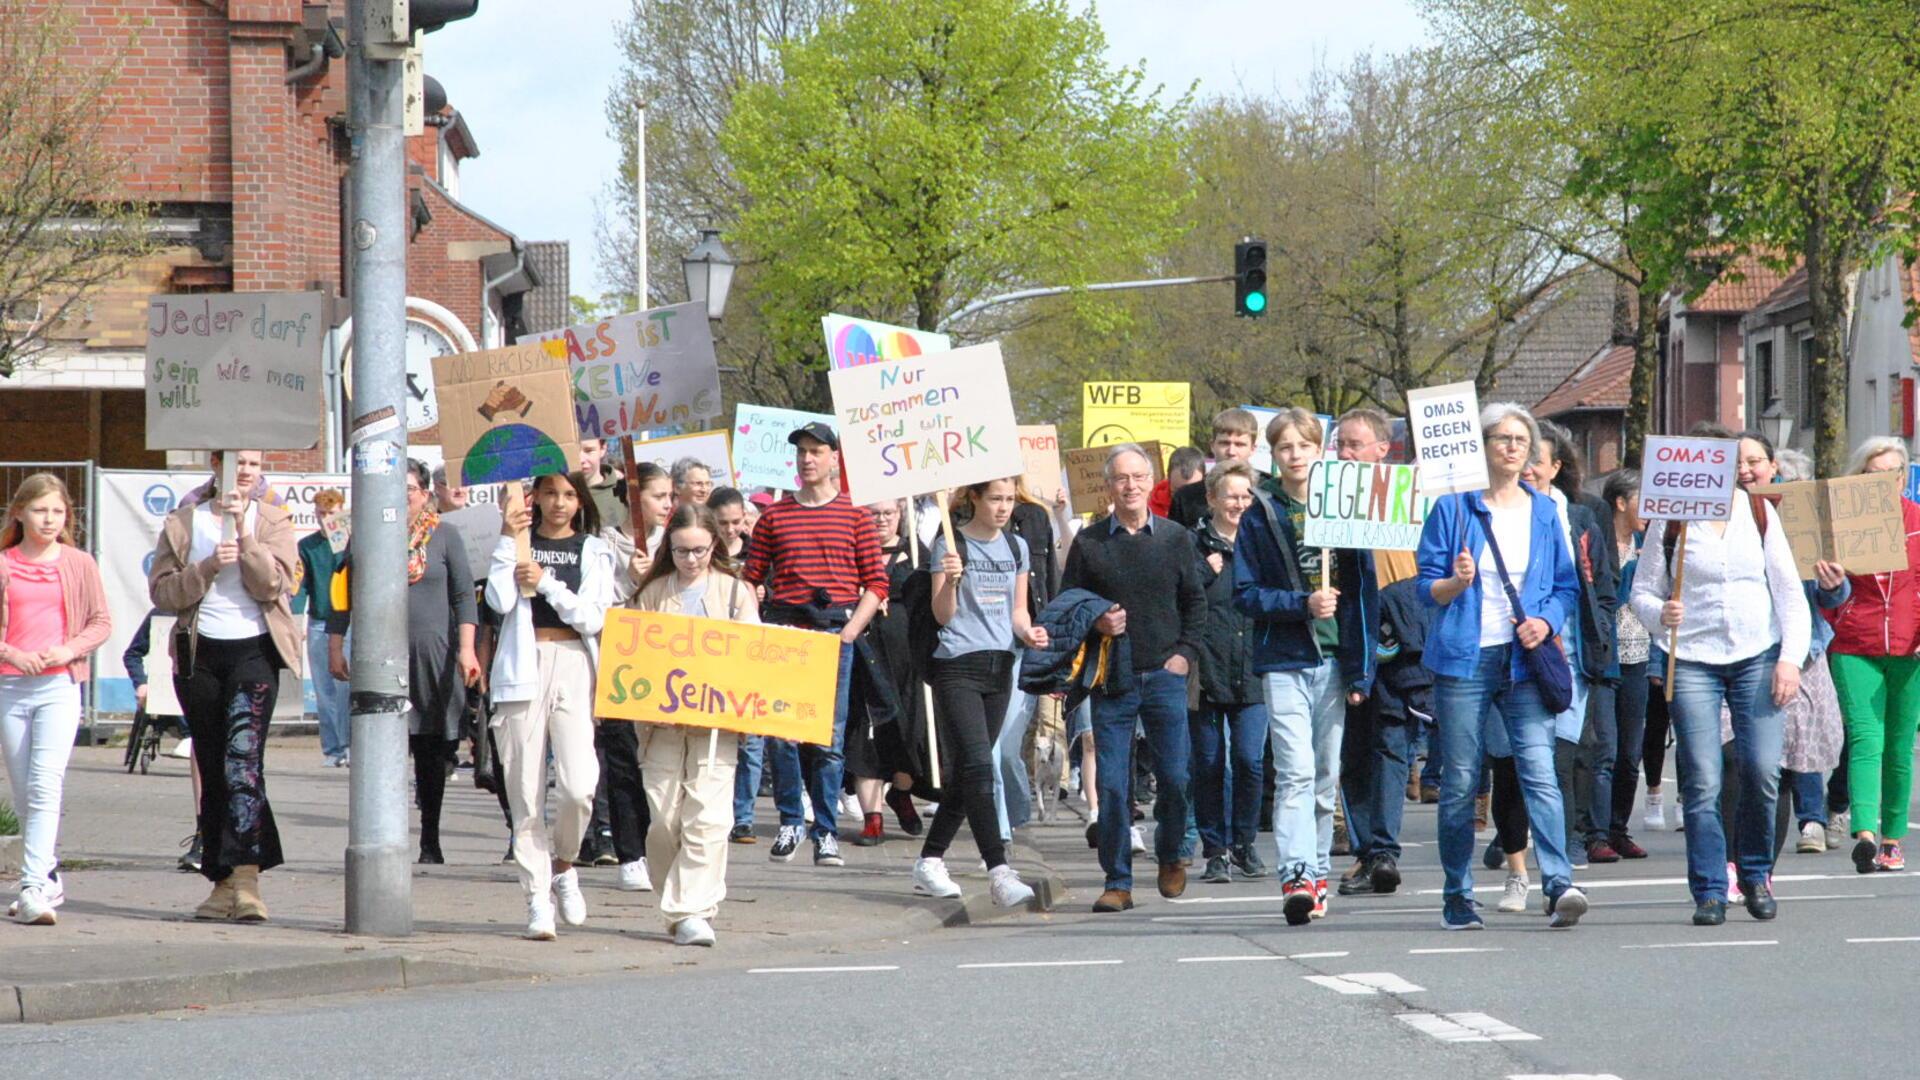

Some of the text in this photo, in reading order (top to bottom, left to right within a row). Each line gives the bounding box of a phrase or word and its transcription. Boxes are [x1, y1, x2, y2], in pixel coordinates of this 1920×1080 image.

[151, 298, 312, 348] Jeder darf
[217, 357, 251, 381] wie
[266, 369, 305, 392] man
[450, 349, 554, 384] NO RACISM
[880, 365, 926, 390] Nur
[159, 385, 201, 409] will
[846, 386, 960, 425] zusammen
[1088, 385, 1141, 405] WFB
[423, 405, 430, 416] 5
[1424, 401, 1465, 418] OMAS
[867, 413, 953, 444] sind wir
[1422, 420, 1471, 439] GEGEN
[881, 425, 989, 477] STARK
[1421, 440, 1478, 460] RECHTS
[1656, 447, 1725, 464] OMA'S
[1307, 460, 1430, 525] GEGEN RE
[1652, 471, 1724, 489] GEGEN
[1643, 498, 1727, 517] RECHTS
[1805, 480, 1895, 522] WIEDER
[1311, 520, 1355, 546] GEGEN
[532, 550, 578, 565] EDNESDAY
[616, 616, 815, 665] Jeder darf
[608, 664, 652, 705] So
[772, 698, 791, 713] er
